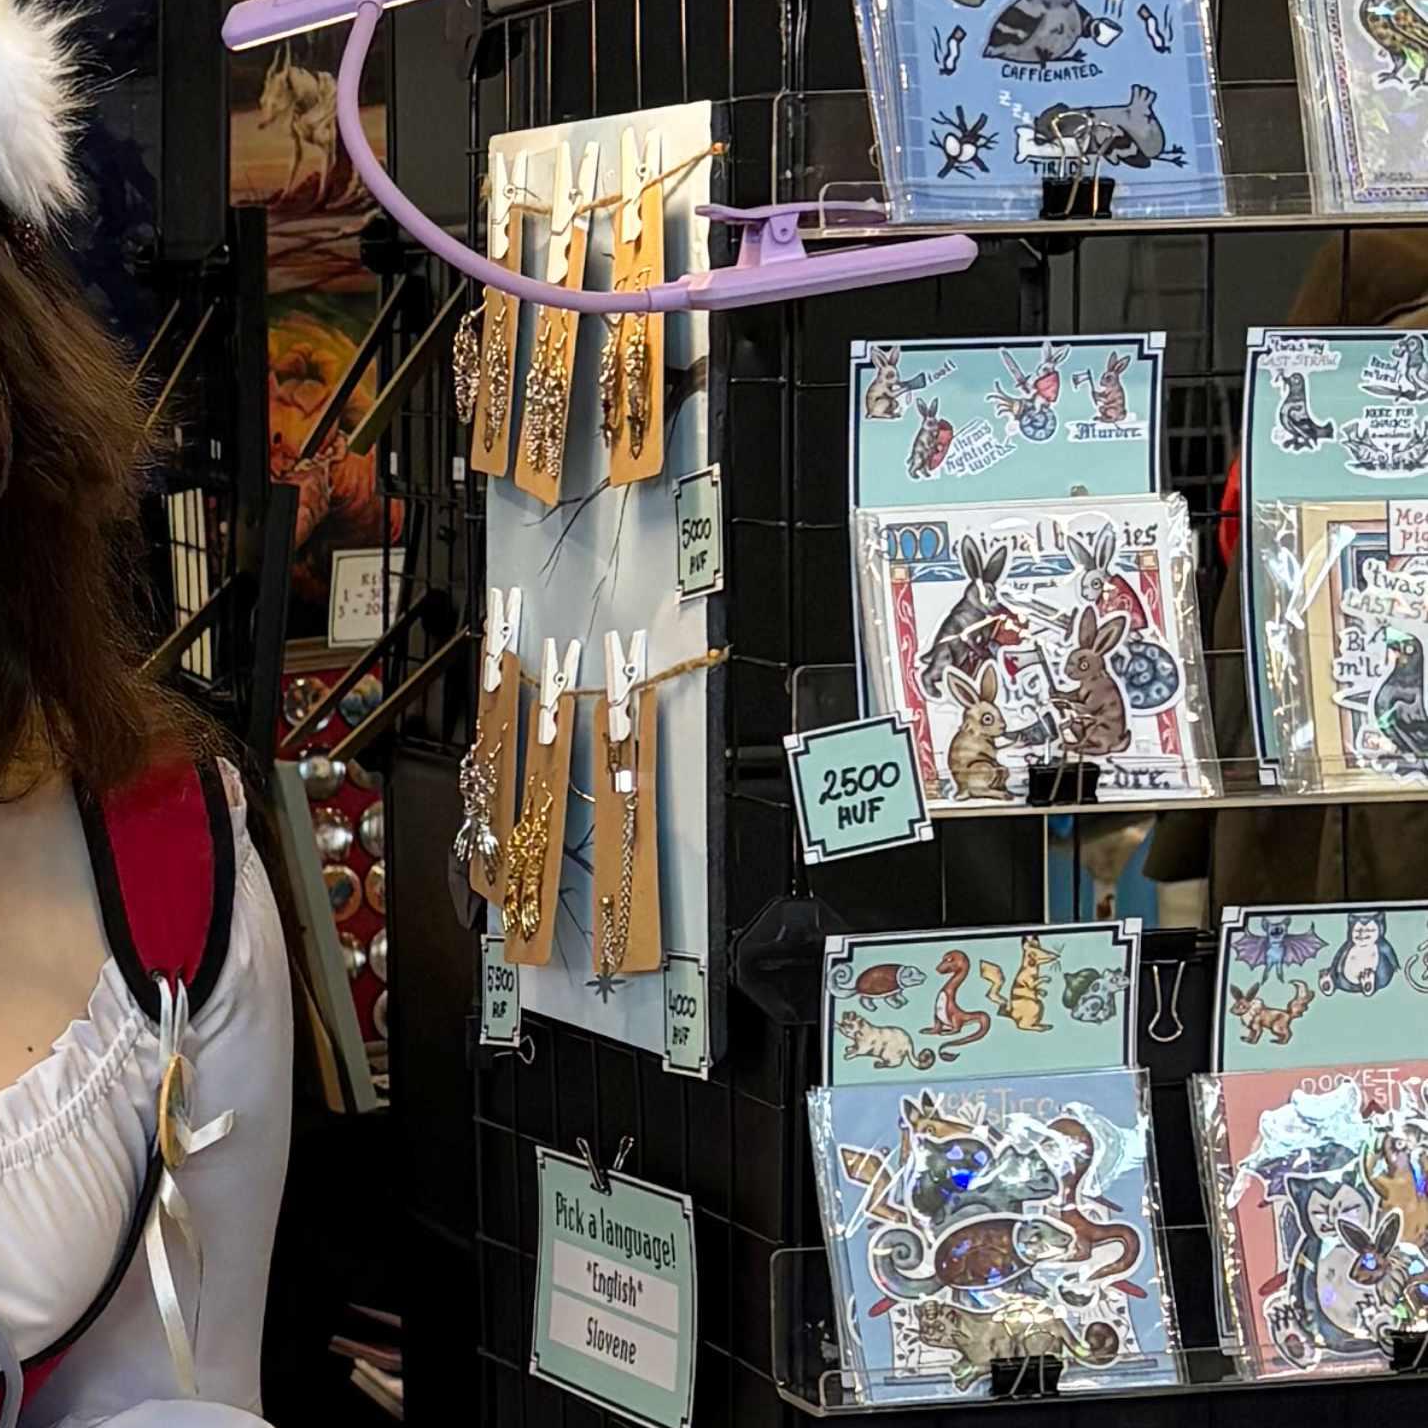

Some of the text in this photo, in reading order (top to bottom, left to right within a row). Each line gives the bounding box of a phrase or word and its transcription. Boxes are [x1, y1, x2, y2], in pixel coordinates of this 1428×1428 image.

[681, 518, 712, 551] 5000
[819, 762, 901, 806] 2500
[837, 796, 886, 828] HUF
[668, 994, 696, 1018] 4000
[555, 1191, 676, 1270] Pick a language!
[586, 1316, 637, 1365] Slovene
